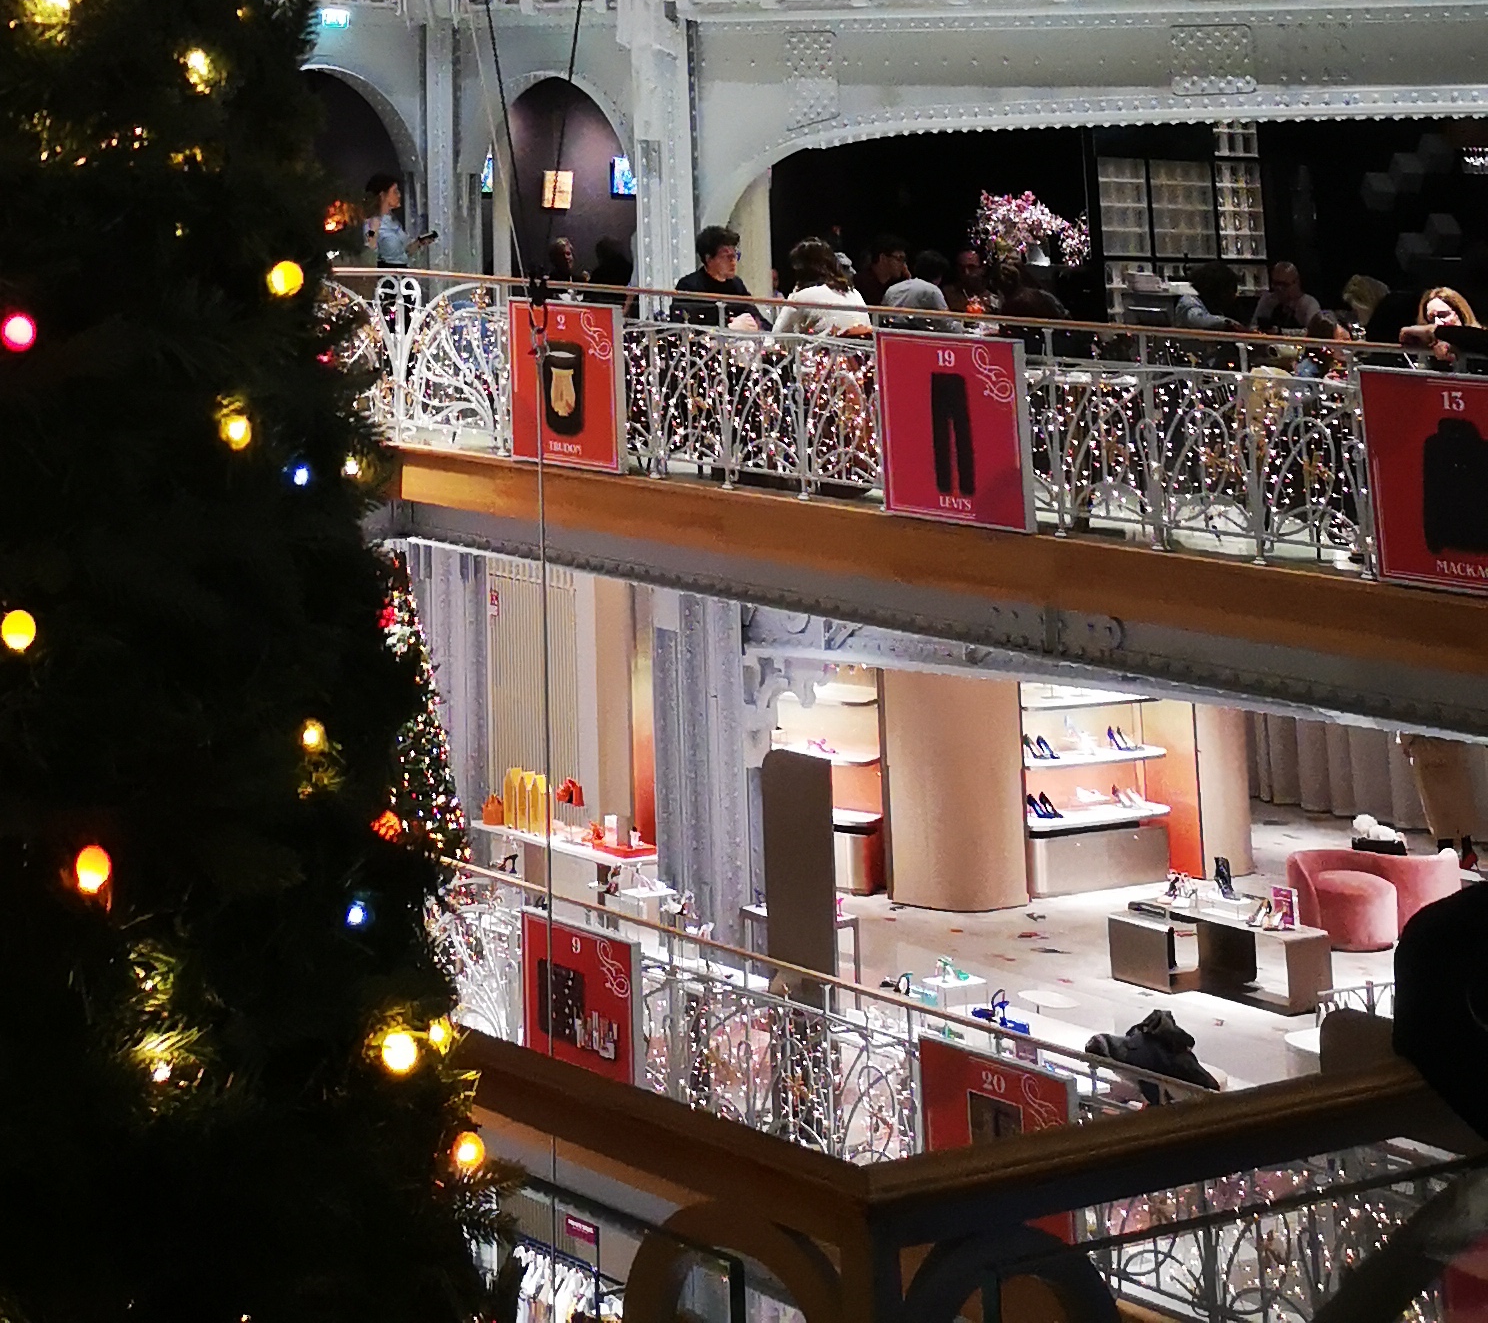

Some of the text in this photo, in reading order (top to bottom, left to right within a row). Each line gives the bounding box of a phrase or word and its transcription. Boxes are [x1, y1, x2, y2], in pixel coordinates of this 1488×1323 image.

[937, 349, 956, 367] 19
[572, 936, 581, 954] 9
[981, 1070, 1006, 1094] 20
